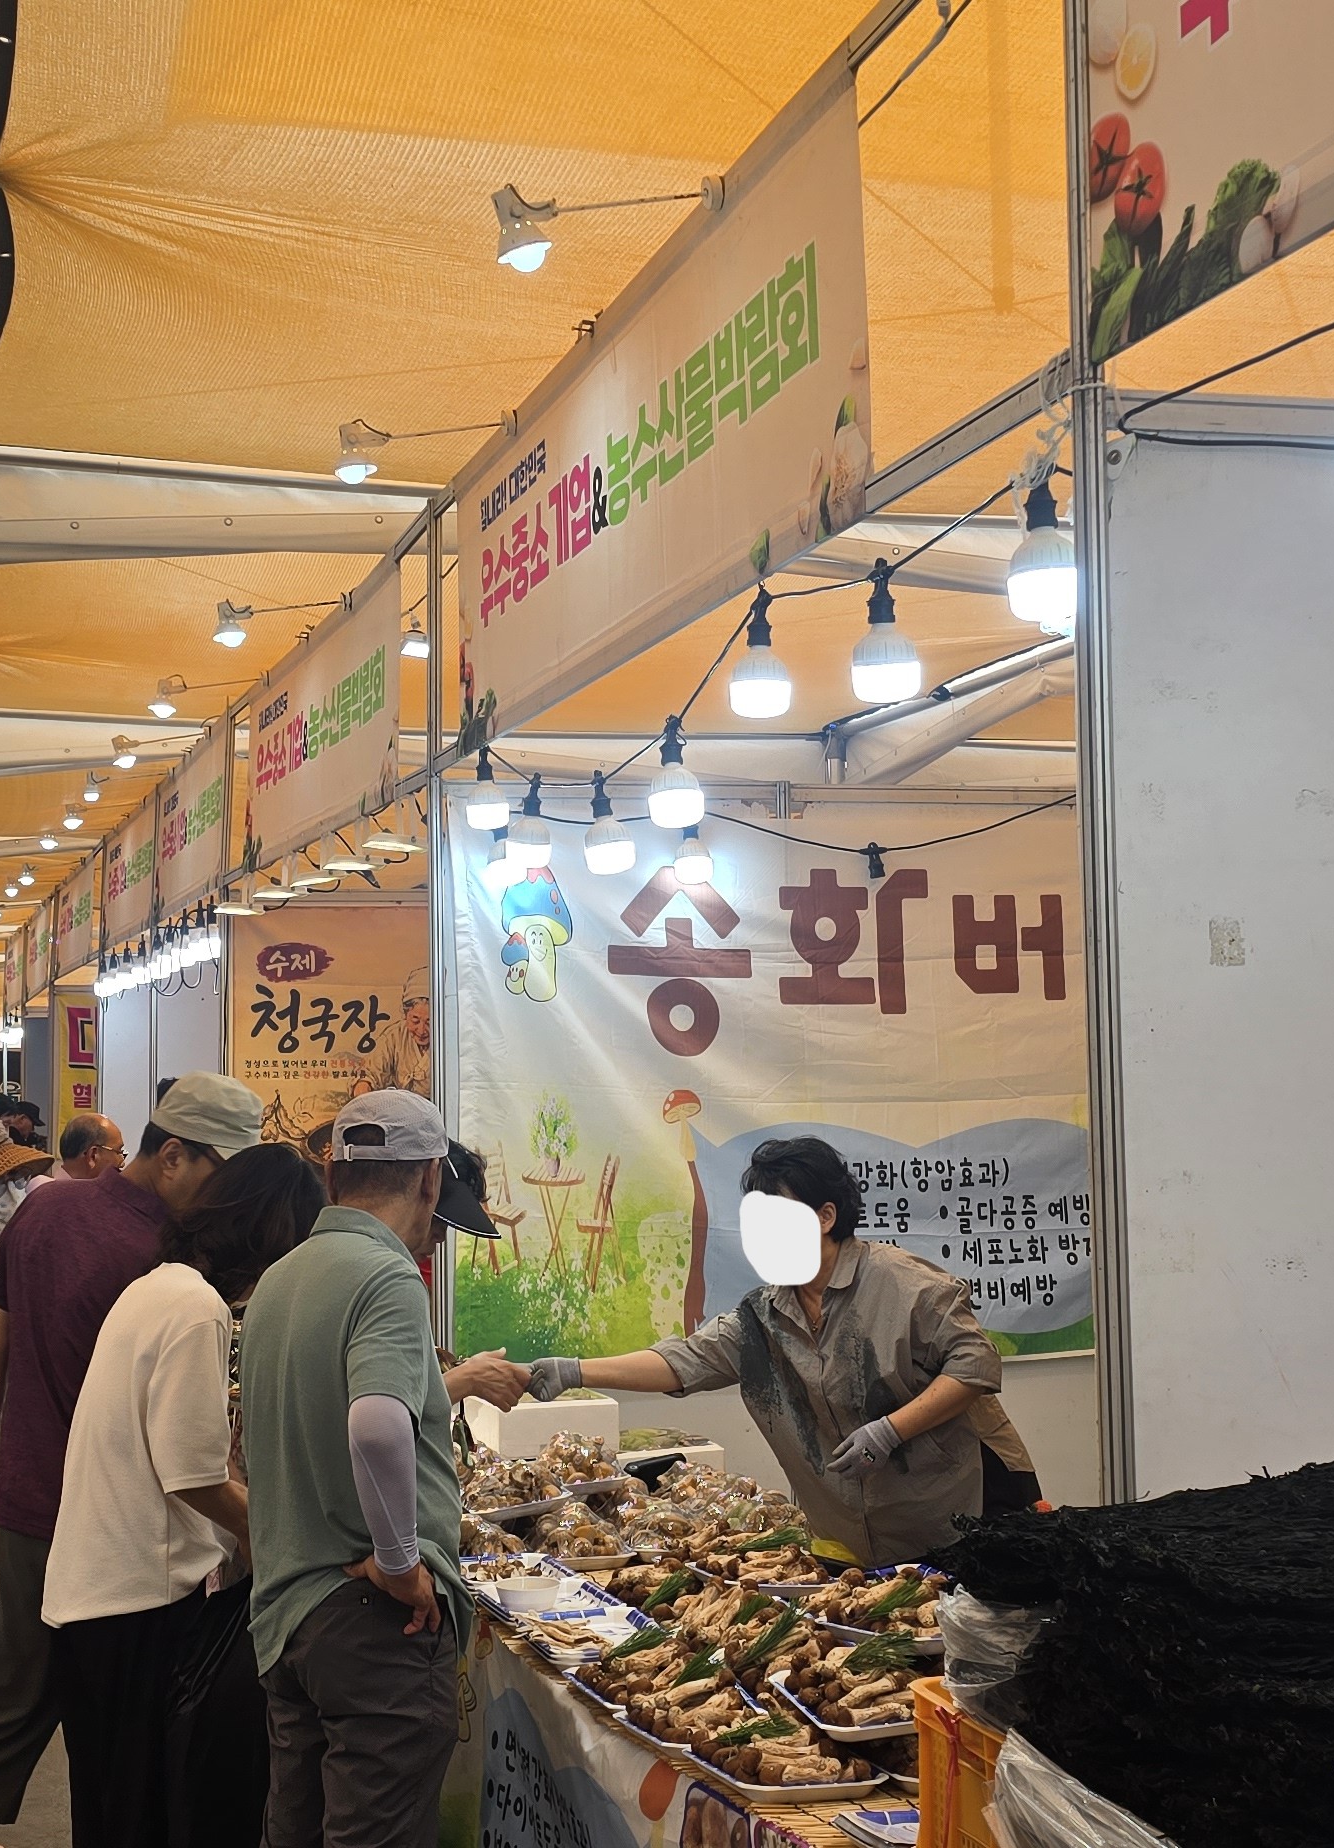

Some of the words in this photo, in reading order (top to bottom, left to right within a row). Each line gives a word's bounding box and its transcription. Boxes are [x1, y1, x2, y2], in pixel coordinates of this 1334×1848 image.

[480, 478, 507, 532] 힘내라!
[509, 438, 547, 505] 대한민국
[266, 950, 316, 977] 수제
[250, 984, 391, 1053] 청국장
[311, 1060, 327, 1068] 우리
[73, 1084, 97, 1110] 혈
[844, 1157, 1010, 1194] 강화(항암효과)
[956, 1195, 1038, 1234] 골다공증
[962, 1235, 1048, 1268] 세포노화
